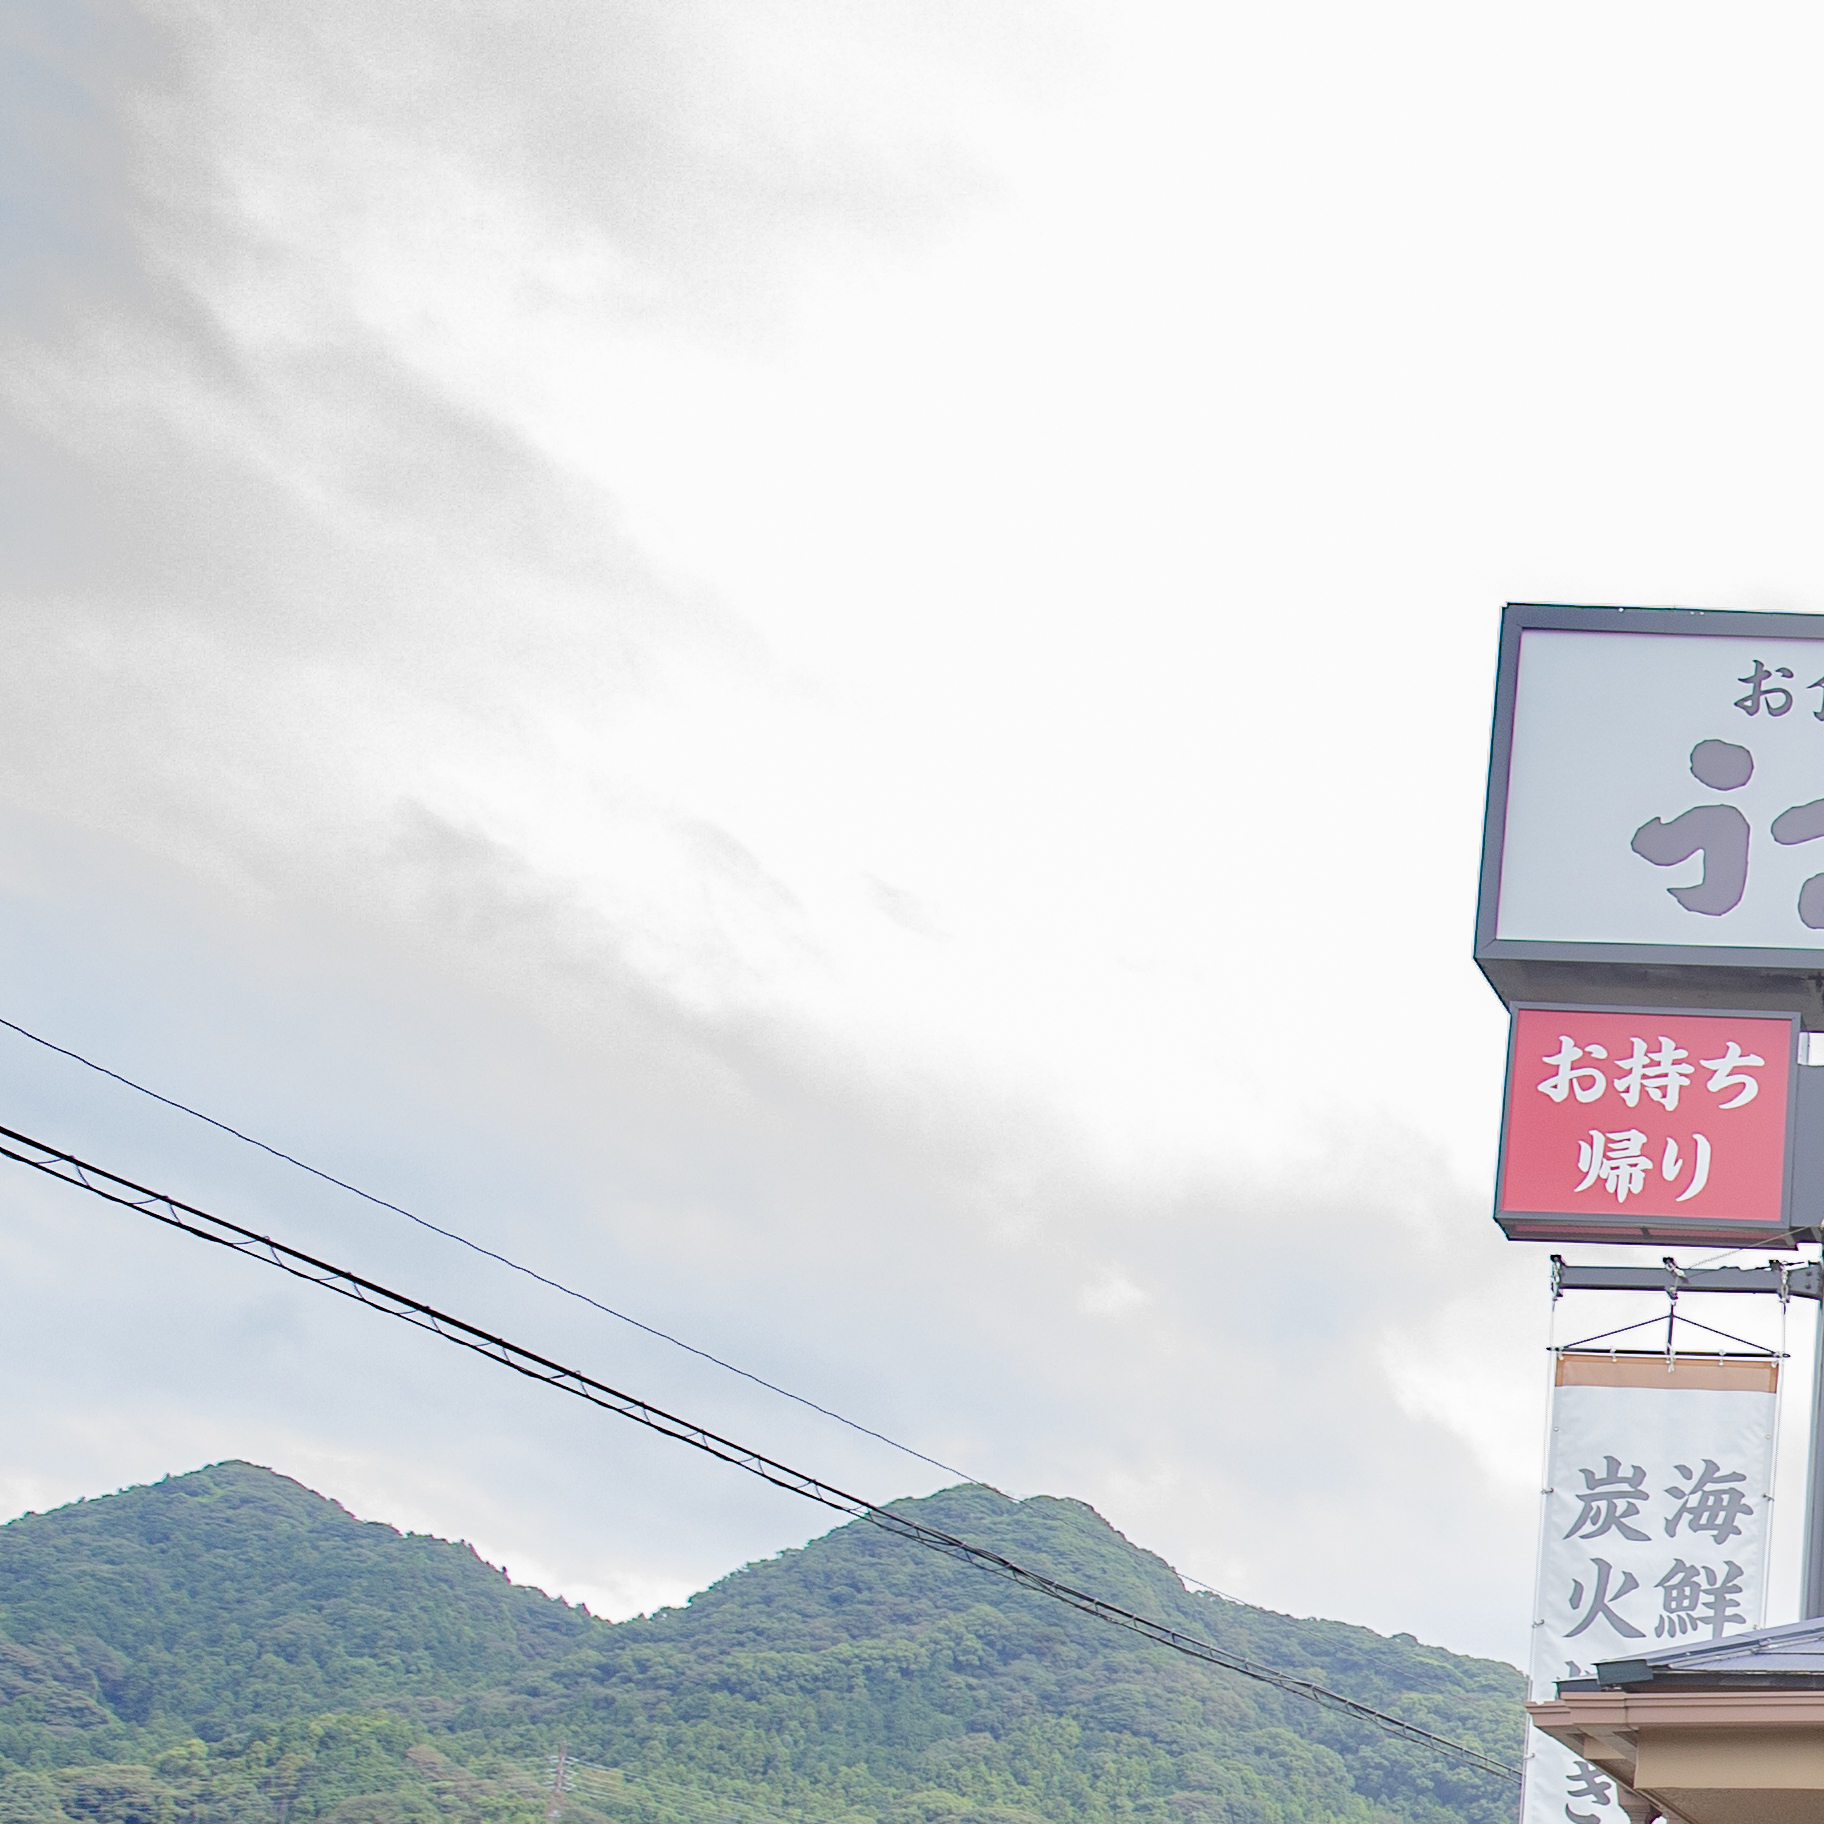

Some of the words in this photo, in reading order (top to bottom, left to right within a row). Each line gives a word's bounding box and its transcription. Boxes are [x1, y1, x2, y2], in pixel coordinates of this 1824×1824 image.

[1537, 1034, 1764, 1111] お持ち
[1575, 1129, 1713, 1203] 帰り
[1654, 1458, 1754, 1639] 海鮮
